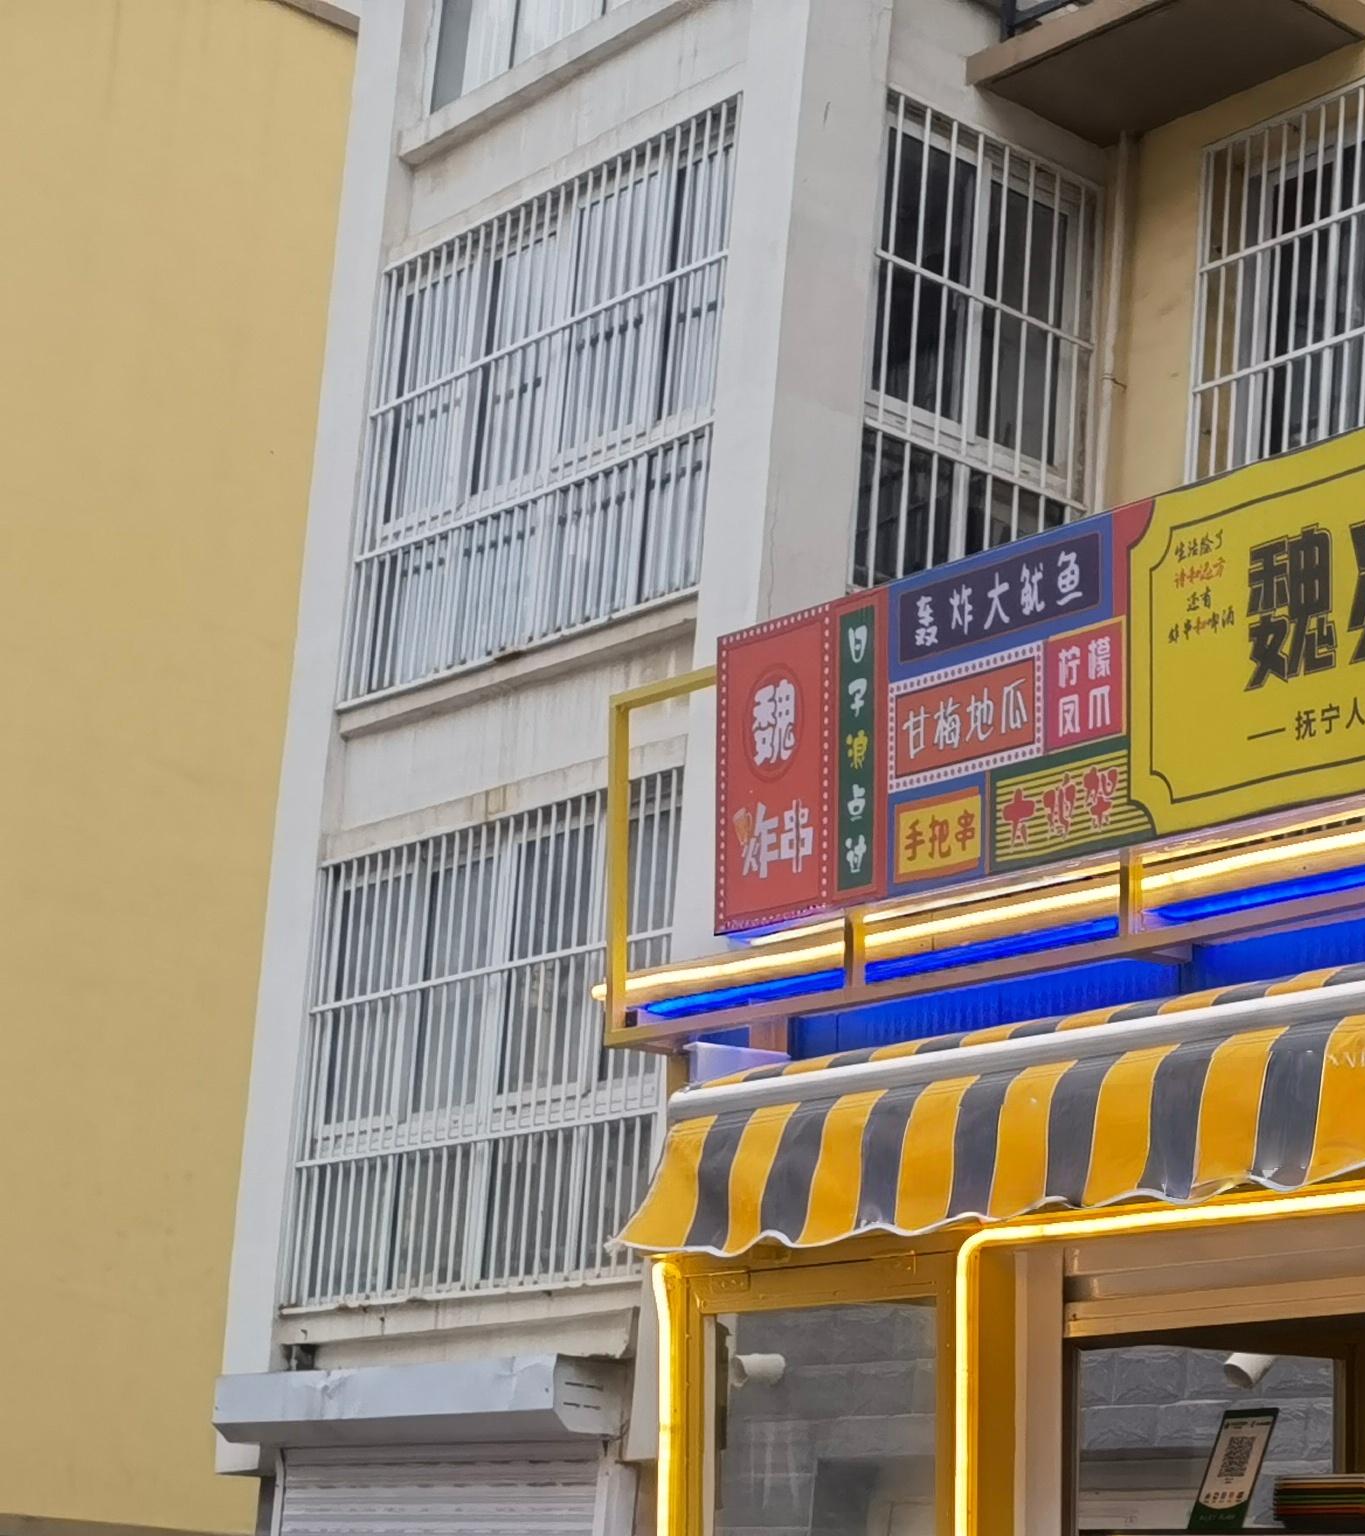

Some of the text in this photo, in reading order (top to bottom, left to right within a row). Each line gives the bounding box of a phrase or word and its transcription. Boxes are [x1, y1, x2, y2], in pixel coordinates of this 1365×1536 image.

[915, 550, 1084, 647] 轰炸大鱿鱼
[1058, 636, 1112, 688] 柠檬
[752, 678, 797, 766] 魏
[845, 625, 868, 874] 日子浪点过
[902, 678, 1029, 760] 甘梅地瓜
[1058, 687, 1112, 738] 凤爪
[738, 800, 814, 879] 炸串
[904, 809, 976, 861] 手把串
[1003, 766, 1118, 850] 大鸡架
